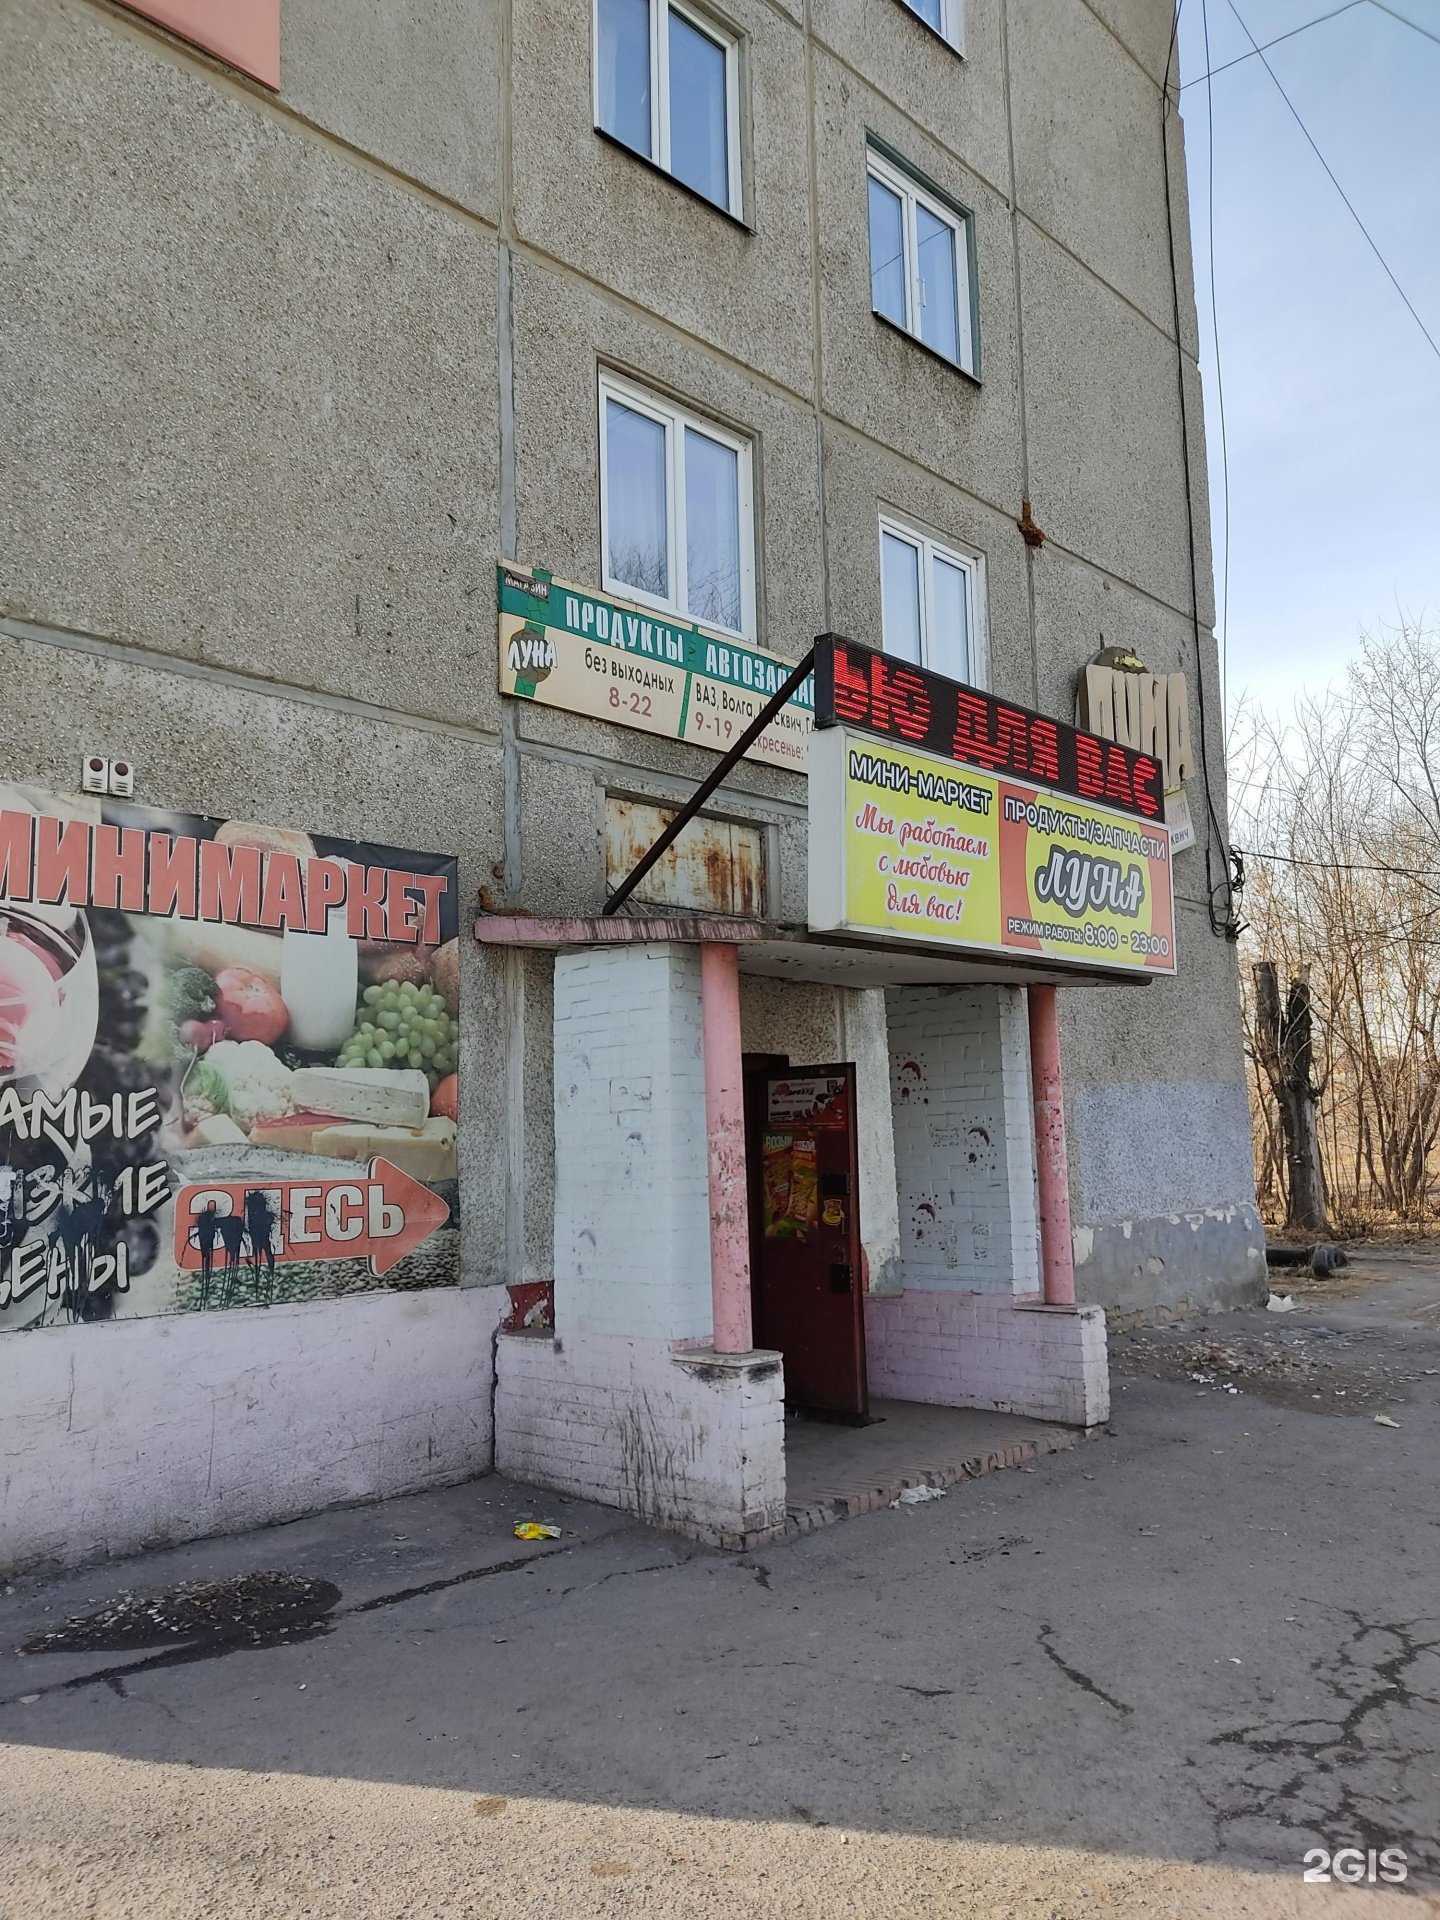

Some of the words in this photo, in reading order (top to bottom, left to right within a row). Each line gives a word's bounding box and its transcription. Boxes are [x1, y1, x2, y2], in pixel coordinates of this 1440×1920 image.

[565, 596, 684, 663] ПРОДУКТЫ
[507, 639, 559, 671] ЛУНА
[585, 648, 607, 674] без
[611, 660, 675, 694] выходных
[706, 643, 815, 707] АВТОЗАПА
[608, 686, 652, 717] 8-22
[695, 711, 732, 738] 9-19
[953, 688, 1059, 782] ДЛЯ
[1076, 733, 1159, 816] ВАС
[850, 751, 992, 815] МИНИ-МАРКЕТ
[856, 803, 895, 835] Мы
[900, 818, 988, 857] работаем
[1004, 796, 1167, 861] ПРОДУКТЫ/ЗАПЧАСТИ
[893, 854, 970, 887] любовью
[1037, 850, 1142, 911] ЛУНА
[888, 883, 922, 914] для
[926, 895, 962, 920] вас!
[1008, 919, 1043, 937] РЕЖИМ
[1045, 925, 1083, 943] РАБОТЫ:
[1084, 924, 1118, 947] 8:00
[1131, 932, 1169, 956] 23:00
